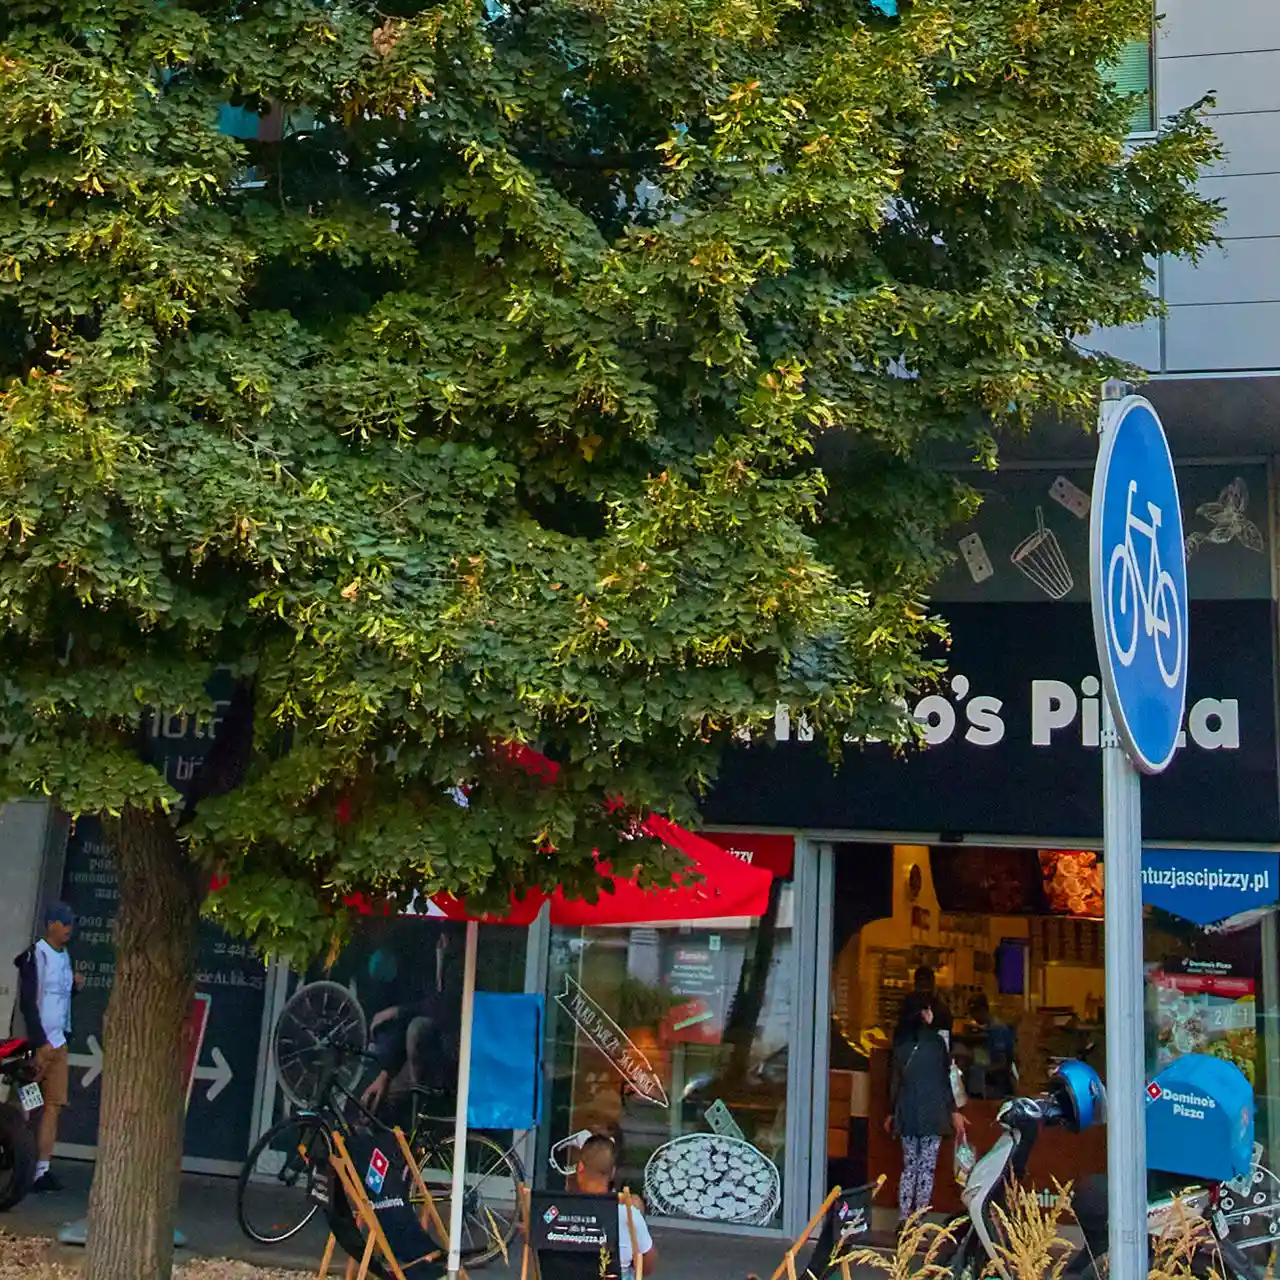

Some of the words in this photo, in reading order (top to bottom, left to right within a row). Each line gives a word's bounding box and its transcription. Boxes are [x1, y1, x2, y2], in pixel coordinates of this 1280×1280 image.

[1032, 676, 1239, 750] Pia
[1140, 867, 1269, 892] ntuzjascipizzy.pl
[1162, 1088, 1215, 1108] Domino's
[1173, 1103, 1205, 1120] Pizza
